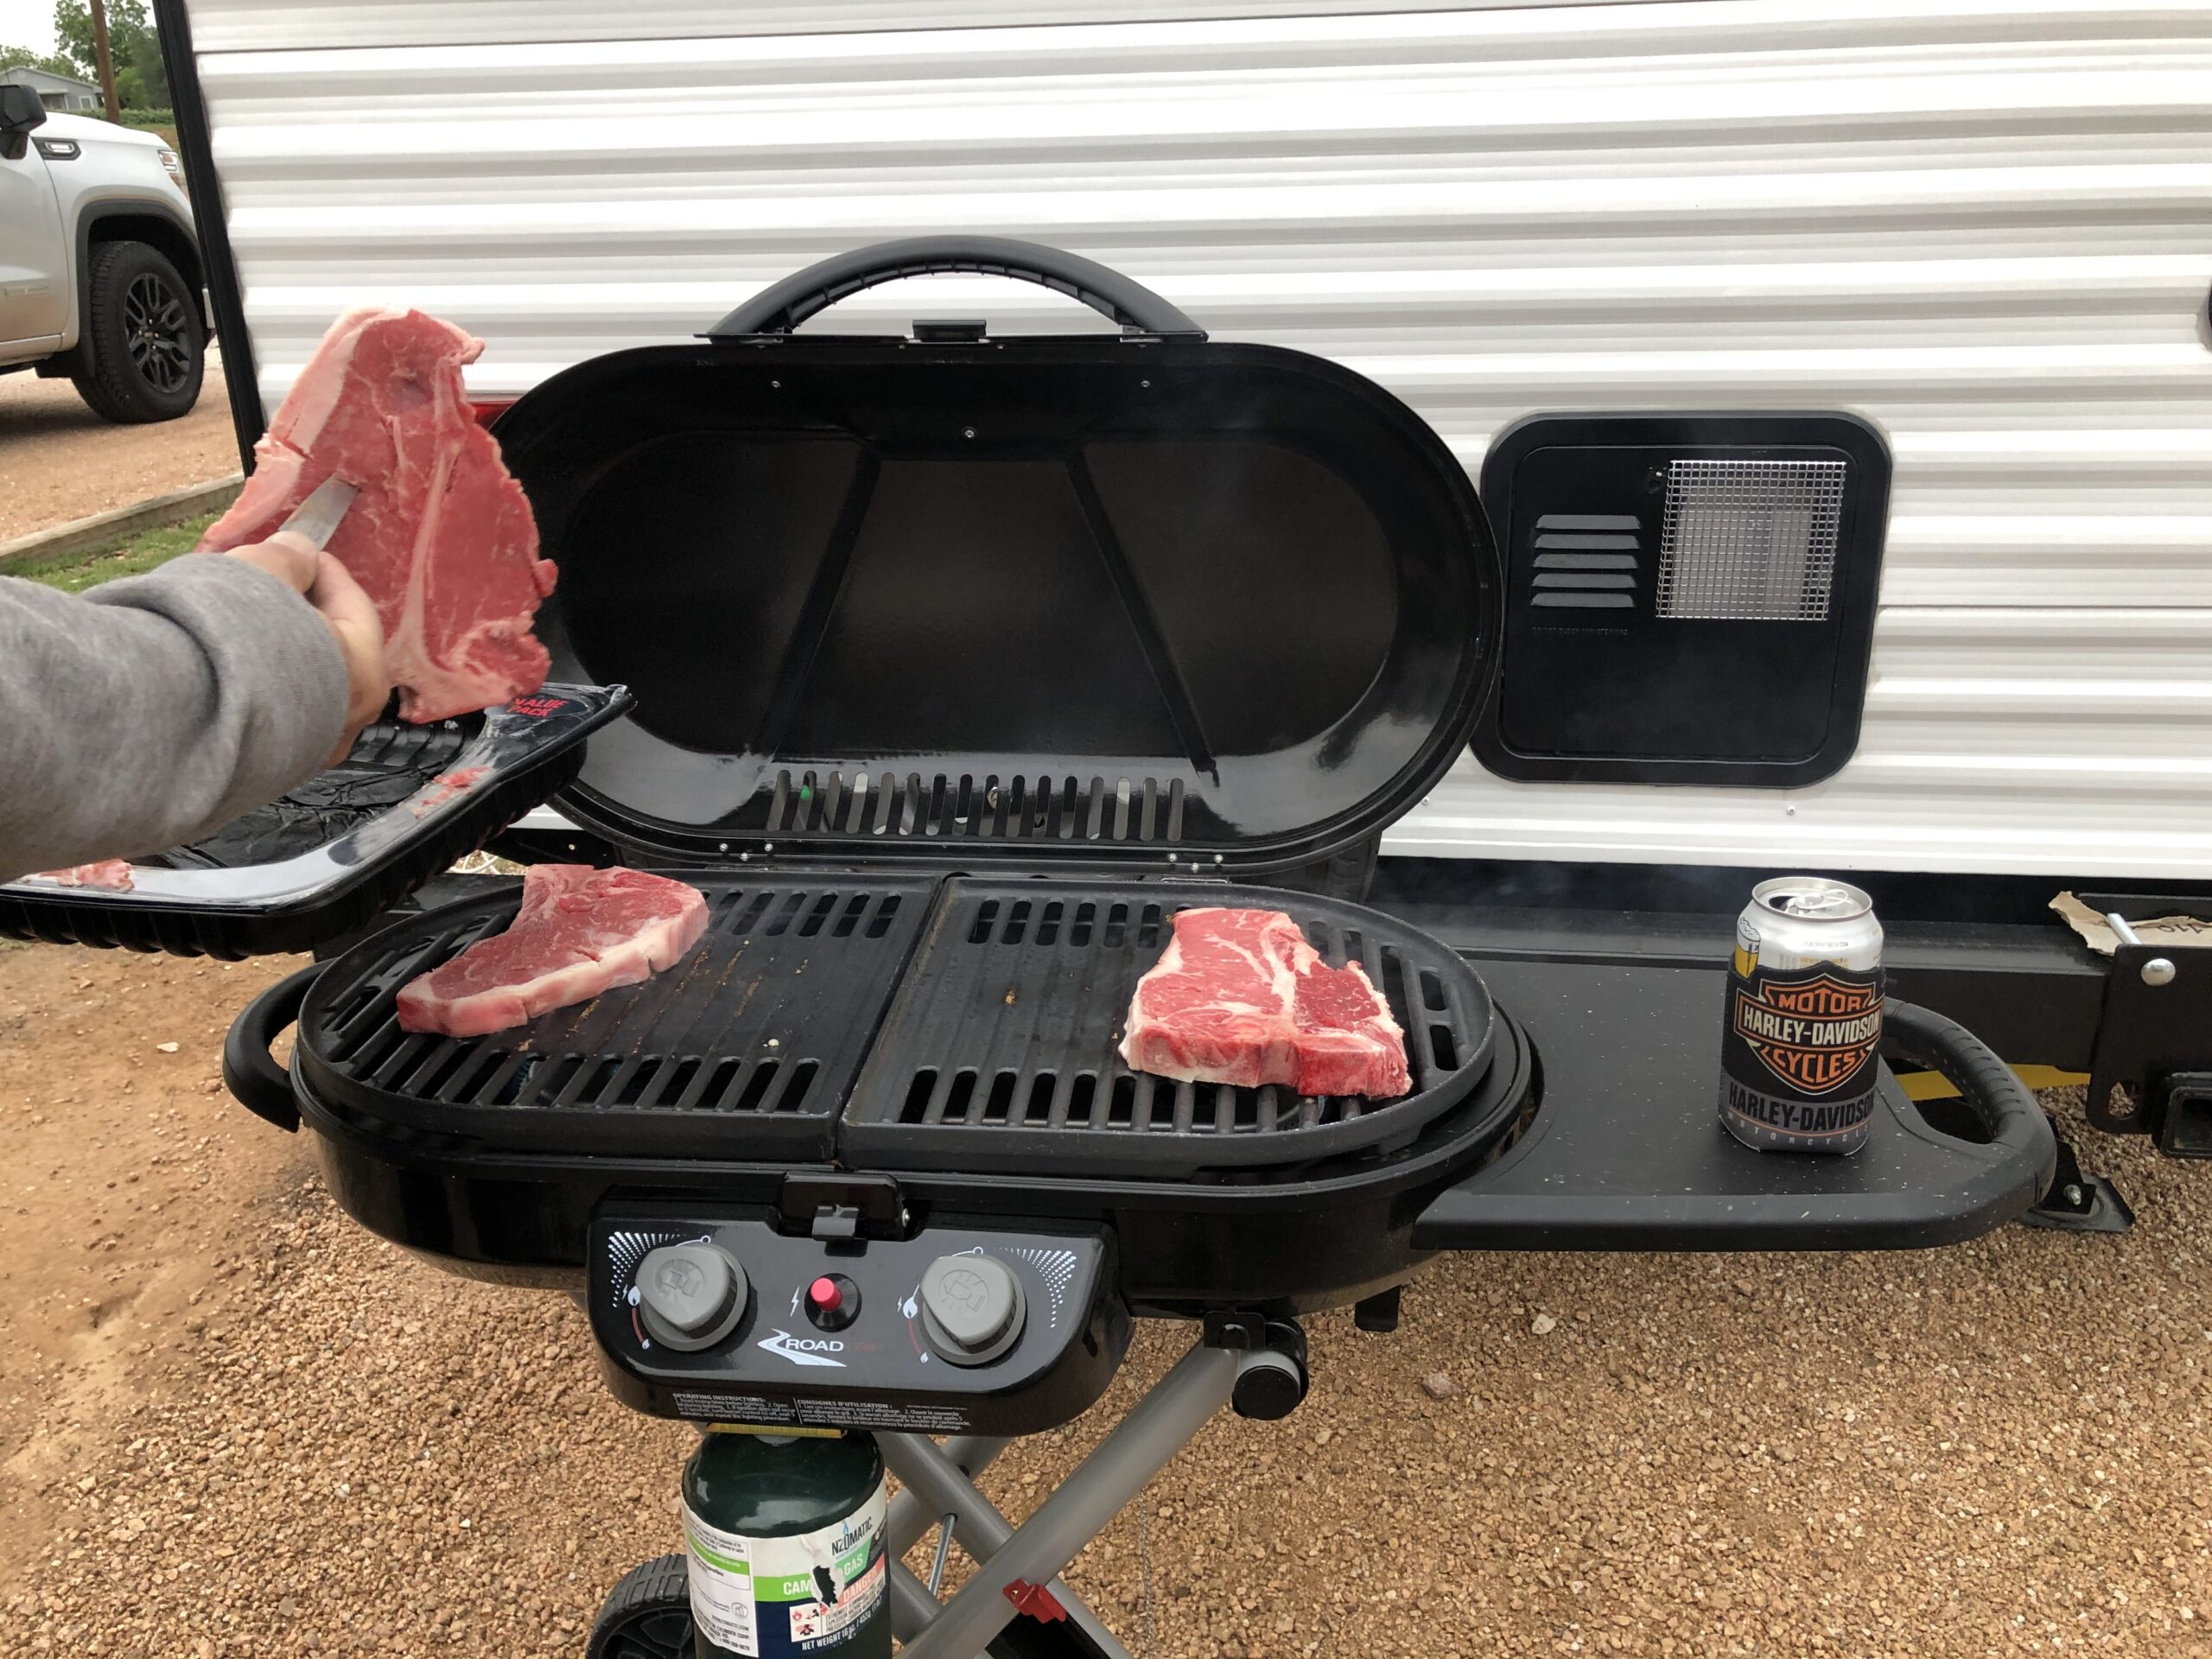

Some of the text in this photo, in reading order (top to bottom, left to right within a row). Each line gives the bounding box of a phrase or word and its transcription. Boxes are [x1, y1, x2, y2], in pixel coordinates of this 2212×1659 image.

[513, 698, 569, 709] VALUE
[1778, 988, 1860, 1014] MOTOR
[1744, 1006, 1880, 1046] HARLEY-DAVIDSON
[1773, 1049, 1856, 1083] CYCLES
[785, 1339, 844, 1351] ROAD
[843, 1553, 863, 1576] GAS
[842, 1568, 877, 1604] DANGER
[802, 1640, 815, 1650] NET
[817, 1632, 841, 1647] WEIGHT
